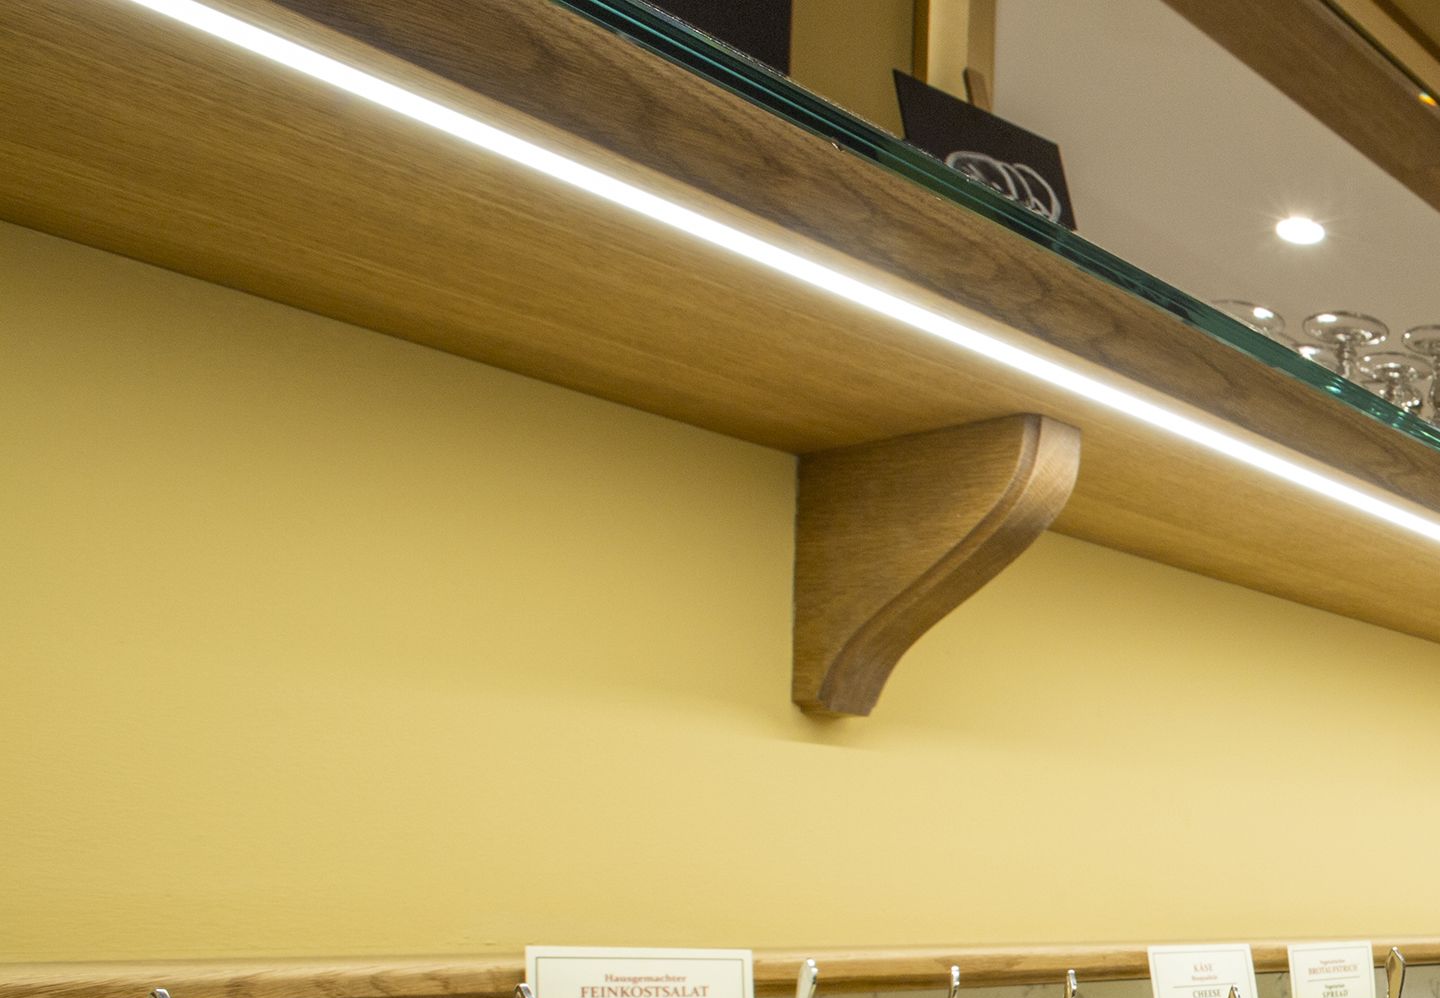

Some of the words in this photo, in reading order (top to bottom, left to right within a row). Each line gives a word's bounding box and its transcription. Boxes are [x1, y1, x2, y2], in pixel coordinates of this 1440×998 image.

[604, 973, 687, 985] Hausgemachter
[580, 985, 710, 998] FEINKOSTSALAT
[1192, 989, 1222, 998] CHEESE
[1322, 990, 1349, 998] SPREAD
